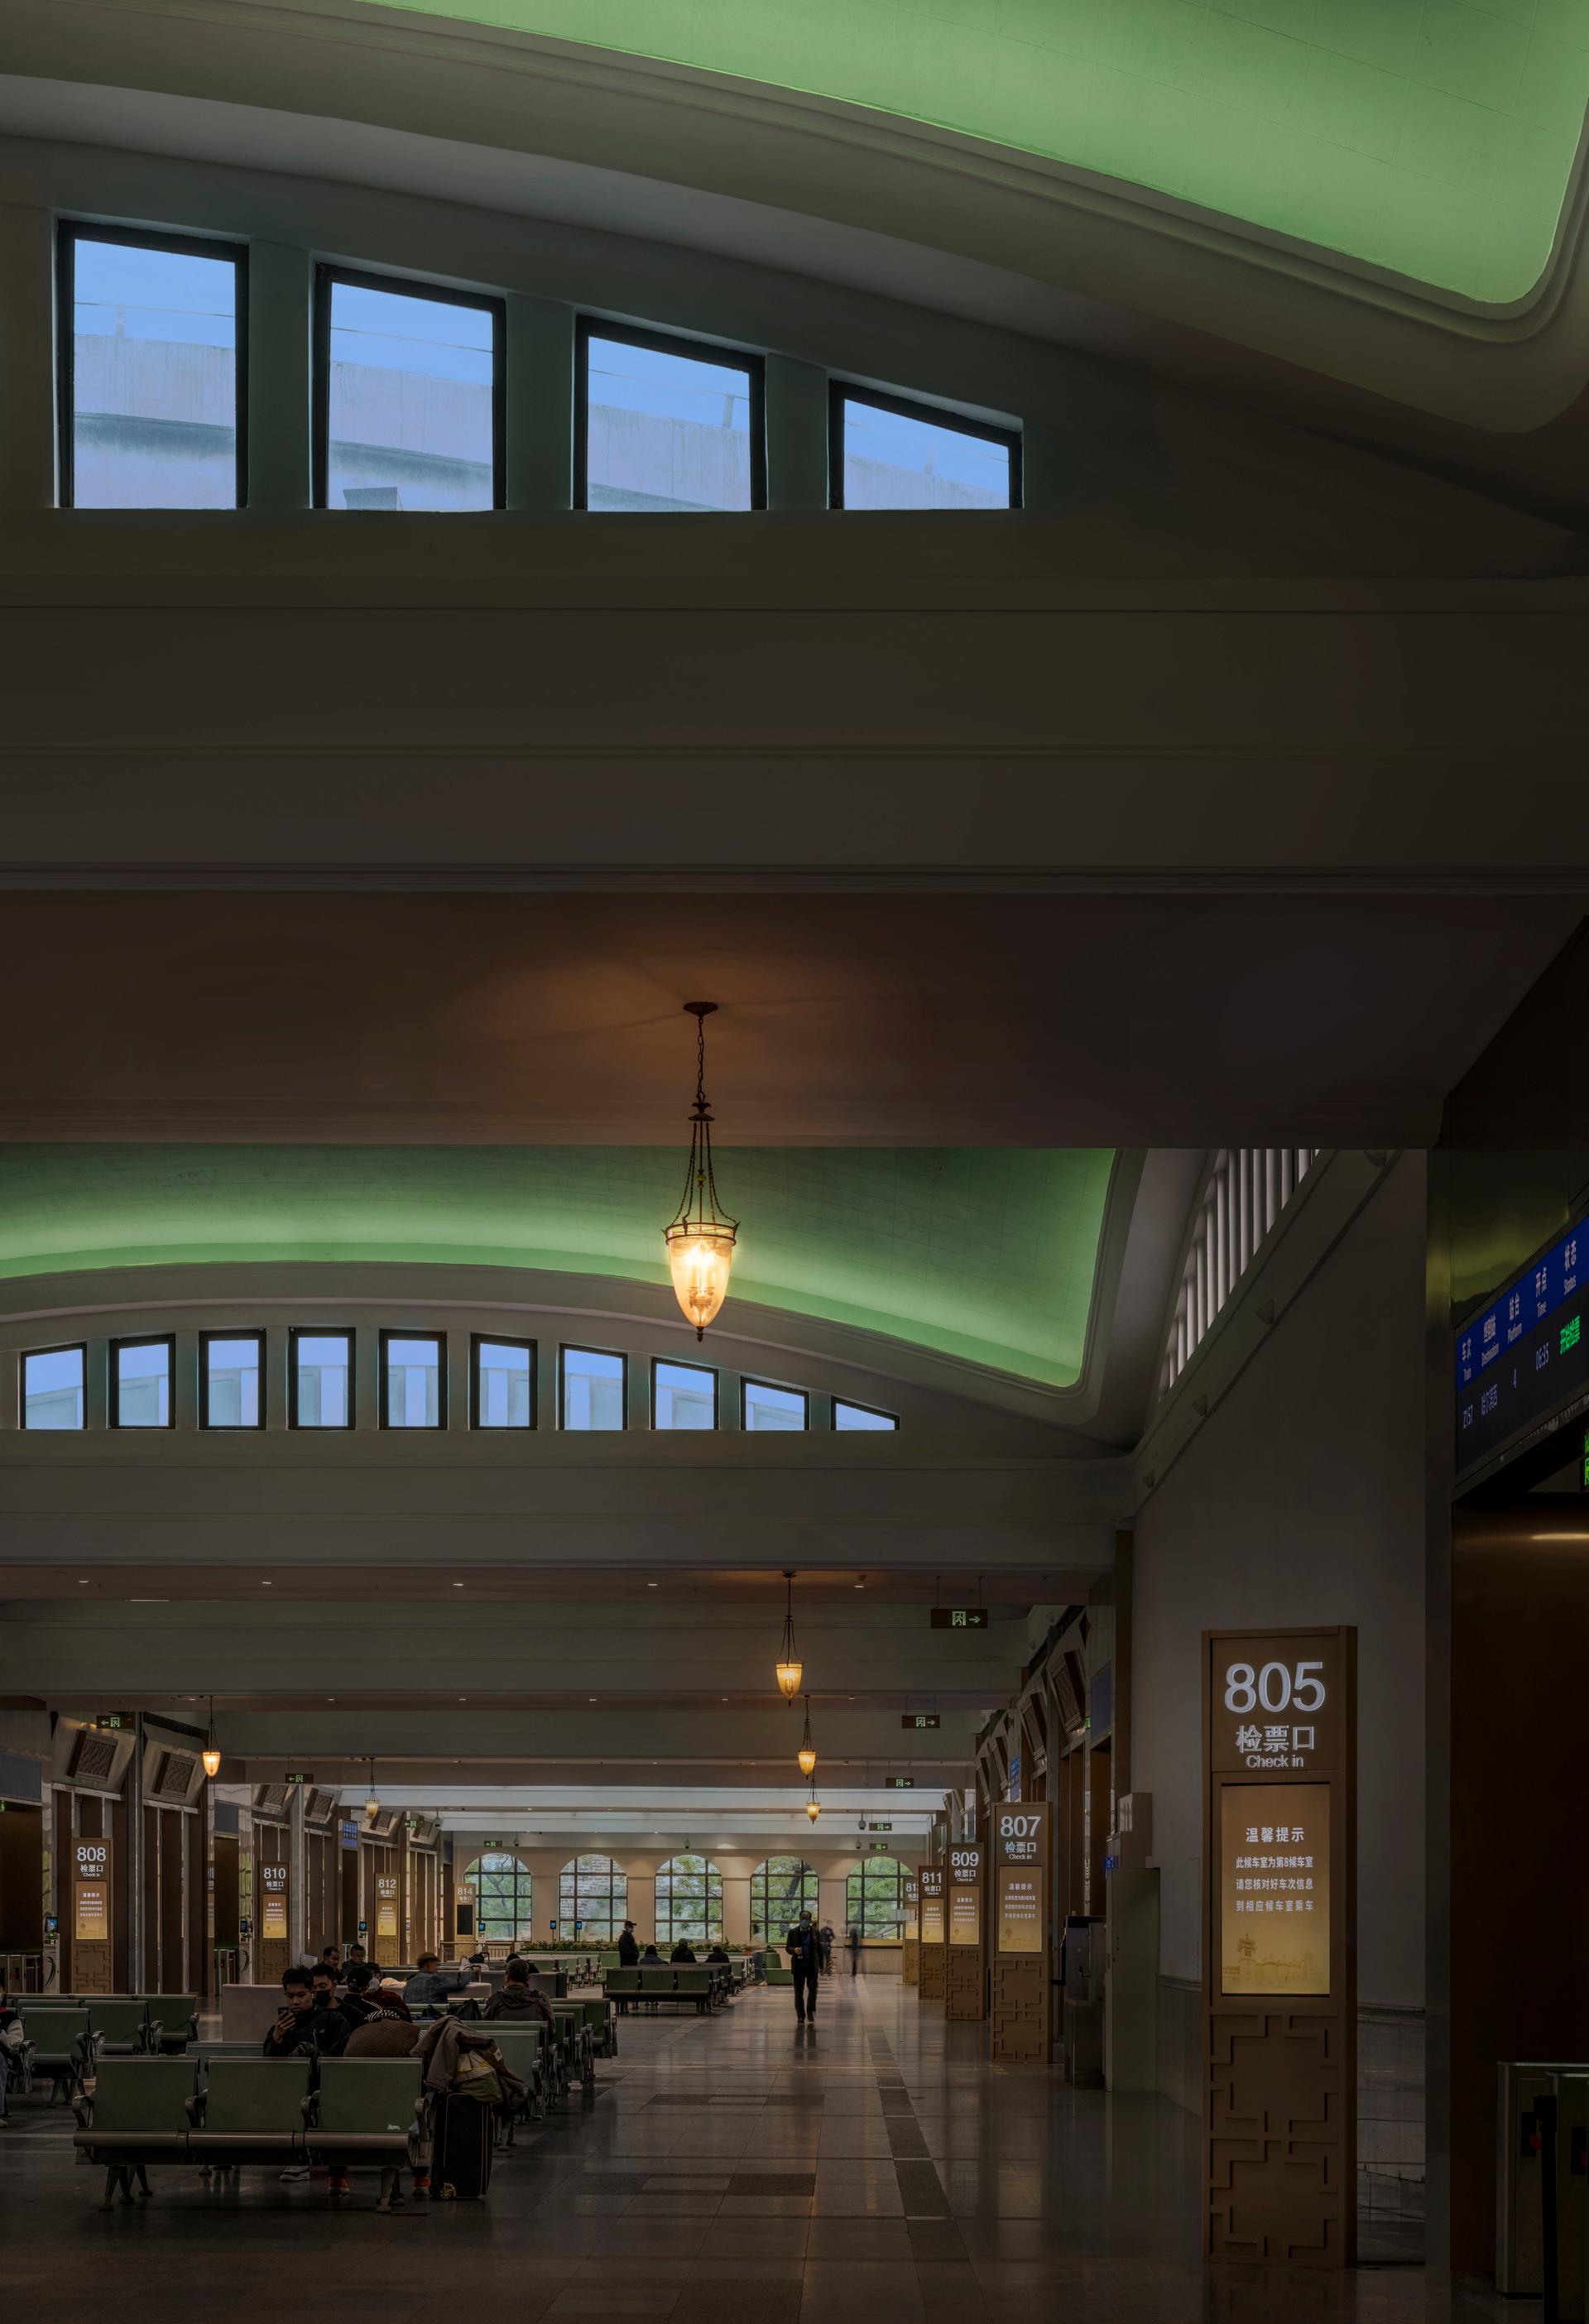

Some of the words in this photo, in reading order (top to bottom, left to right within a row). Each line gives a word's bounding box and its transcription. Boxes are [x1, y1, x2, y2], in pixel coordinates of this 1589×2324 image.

[1563, 1275, 1577, 1295] Status
[1462, 1337, 1471, 1362] 车次
[1509, 1292, 1520, 1322] 站台
[1535, 1266, 1547, 1298] 开点
[1563, 1239, 1577, 1271] 状态
[1224, 1661, 1326, 1713] 805
[1235, 1725, 1314, 1754] 检票口
[1246, 1755, 1289, 1769] Check
[1292, 1755, 1304, 1768] in
[1000, 1816, 1041, 1837] 807
[1246, 1827, 1304, 1842] 温馨提示
[77, 1846, 107, 1861] 808
[1005, 1841, 1037, 1854] 检票口
[951, 1851, 979, 1867] 809
[1236, 1856, 1313, 1869] 此候车室为第8候车室
[79, 1864, 103, 1873] 检票口
[264, 1867, 286, 1880] 810
[954, 1870, 977, 1879] 检票口
[378, 1879, 396, 1889] 812
[922, 1872, 942, 1884] 811
[1236, 1878, 1313, 1891] 请您核对好车次信息
[905, 1883, 919, 1892] 81
[1236, 1899, 1313, 1913] 到相应候车室乘车
